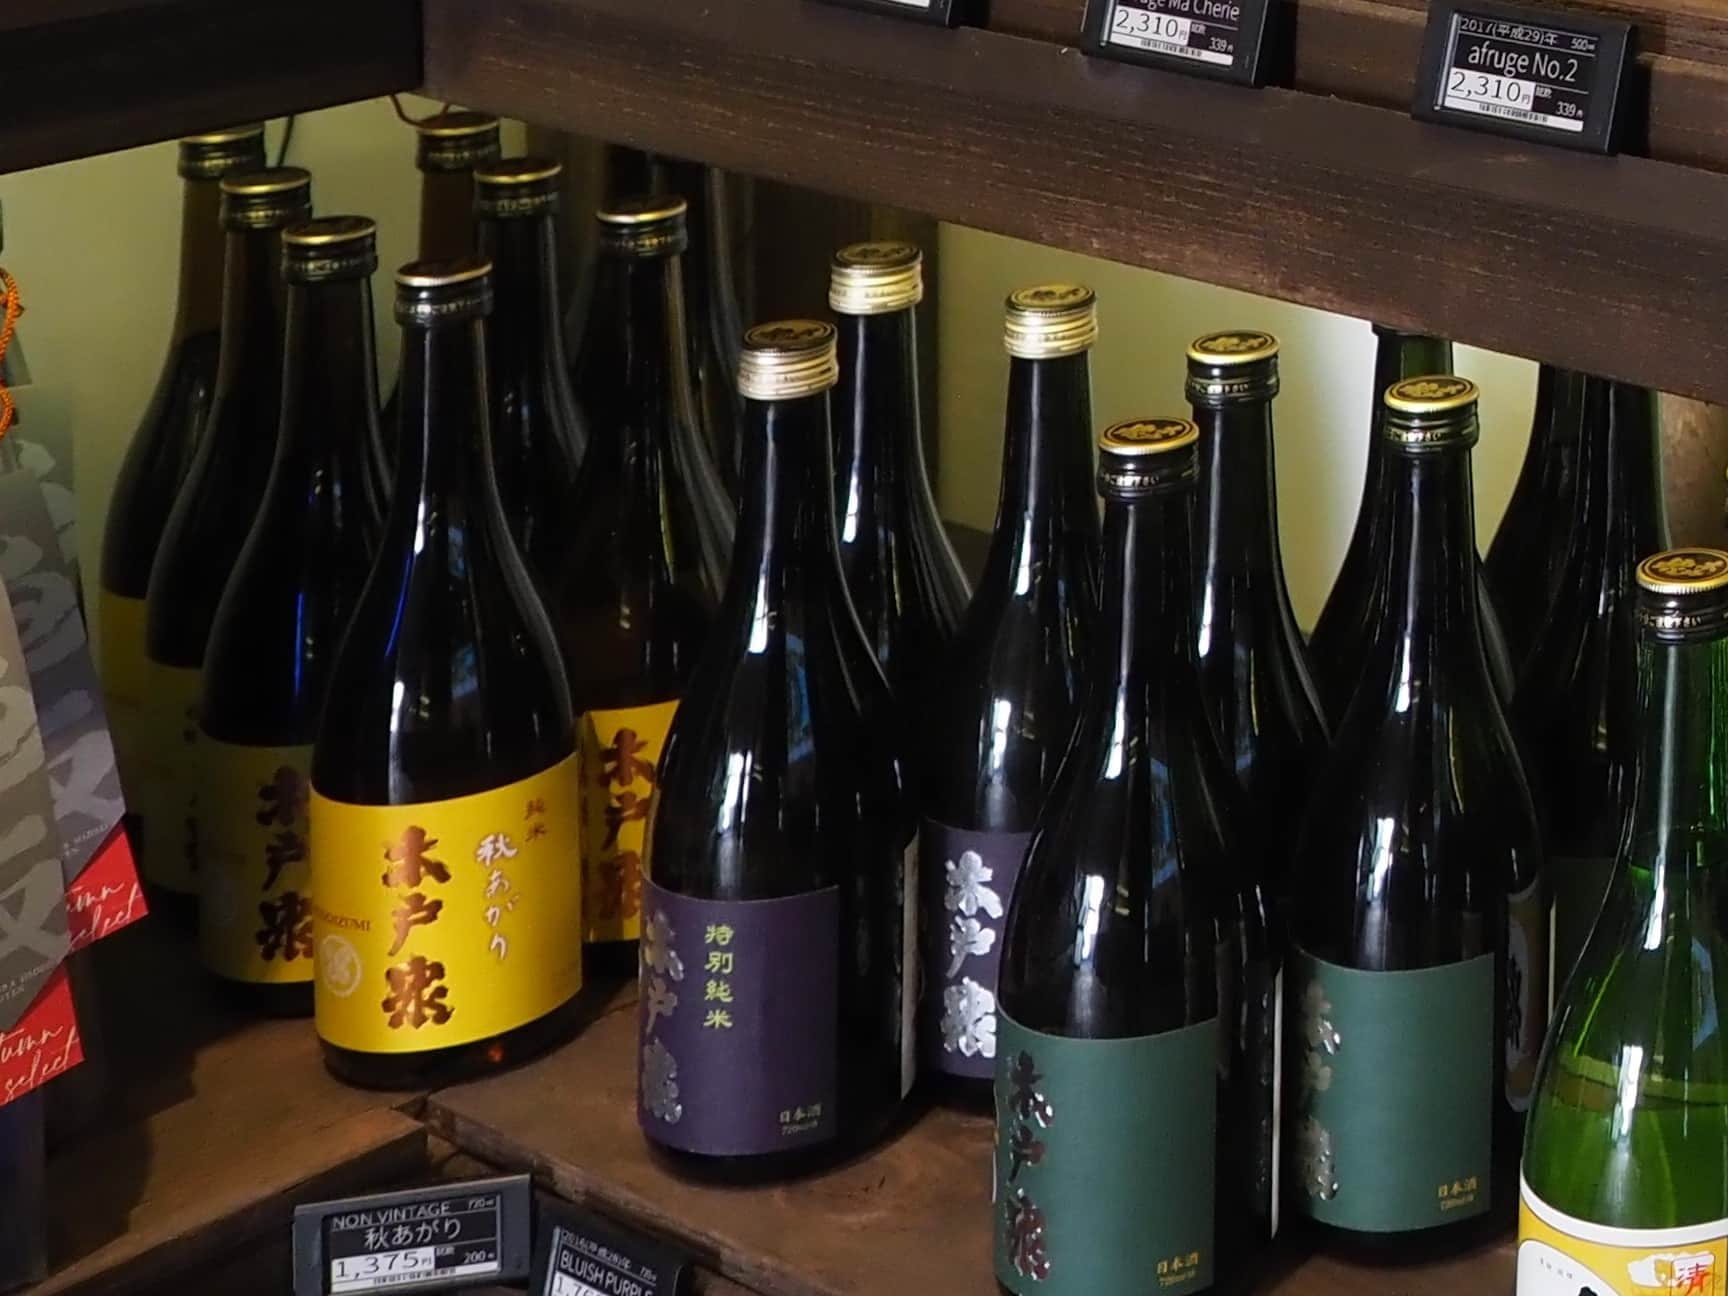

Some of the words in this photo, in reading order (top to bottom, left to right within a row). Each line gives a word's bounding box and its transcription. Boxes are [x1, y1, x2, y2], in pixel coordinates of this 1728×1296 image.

[1116, 9, 1188, 41] 2,310円
[1467, 40, 1530, 77] afruge
[1531, 52, 1579, 83] No.2
[1450, 70, 1531, 106] 2,310円
[475, 832, 520, 961] 秋あがり
[381, 824, 455, 1030] 木戸泉
[702, 923, 735, 1031] 特別純米
[1437, 1175, 1478, 1199] 日本酒
[332, 1212, 376, 1230] NON
[378, 1201, 450, 1226] VINTAGE
[364, 1220, 461, 1251] 秋あがり
[335, 1251, 433, 1280] 1,375円
[560, 1249, 605, 1286] BLUISH
[1155, 1250, 1200, 1276] 日本酒
